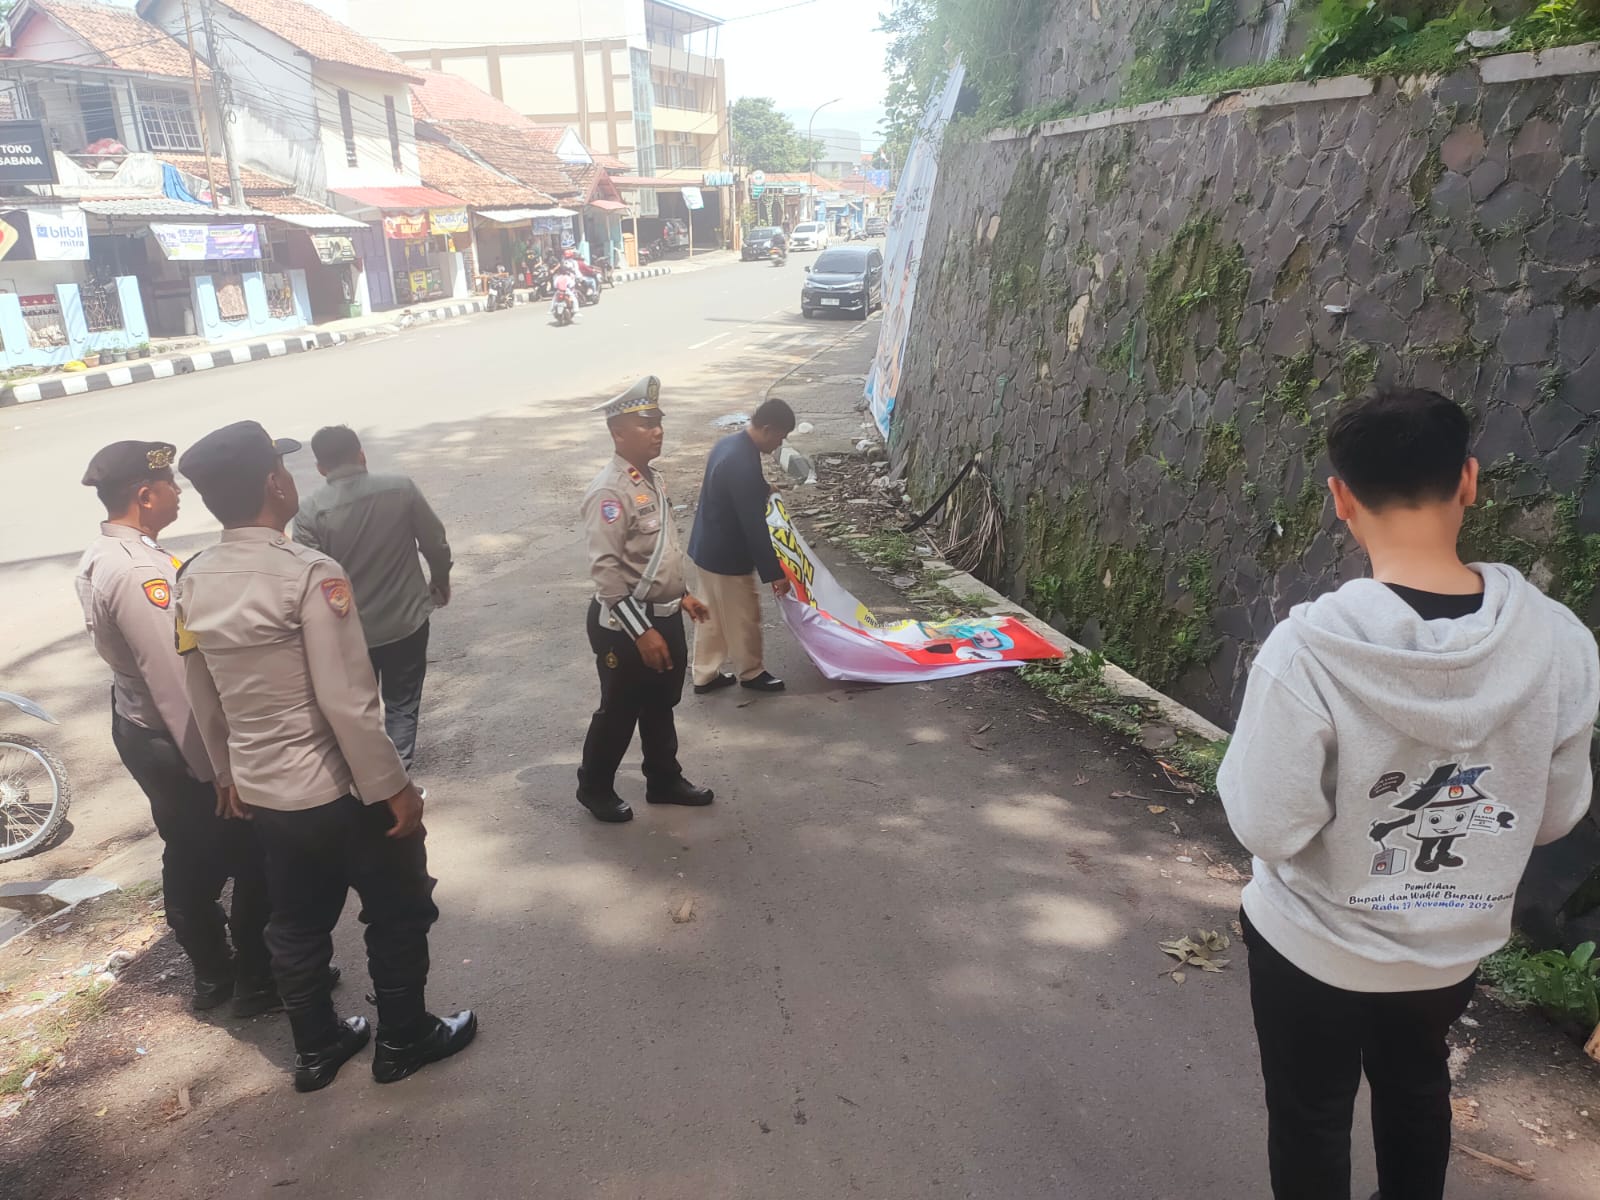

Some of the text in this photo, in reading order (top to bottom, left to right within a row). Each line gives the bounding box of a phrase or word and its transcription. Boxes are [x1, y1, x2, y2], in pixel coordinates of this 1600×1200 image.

[0, 144, 32, 154] TOKO
[49, 226, 84, 238] blibli
[60, 239, 85, 247] mitra
[1404, 882, 1456, 891] Pemilihan
[1349, 893, 1386, 905] Bupati
[1389, 892, 1408, 902] dan
[1410, 890, 1441, 900] Wakil
[1443, 890, 1483, 901] Bupati
[1371, 902, 1400, 911] Rabu
[1414, 899, 1465, 909] November
[1468, 901, 1494, 910] 2024
